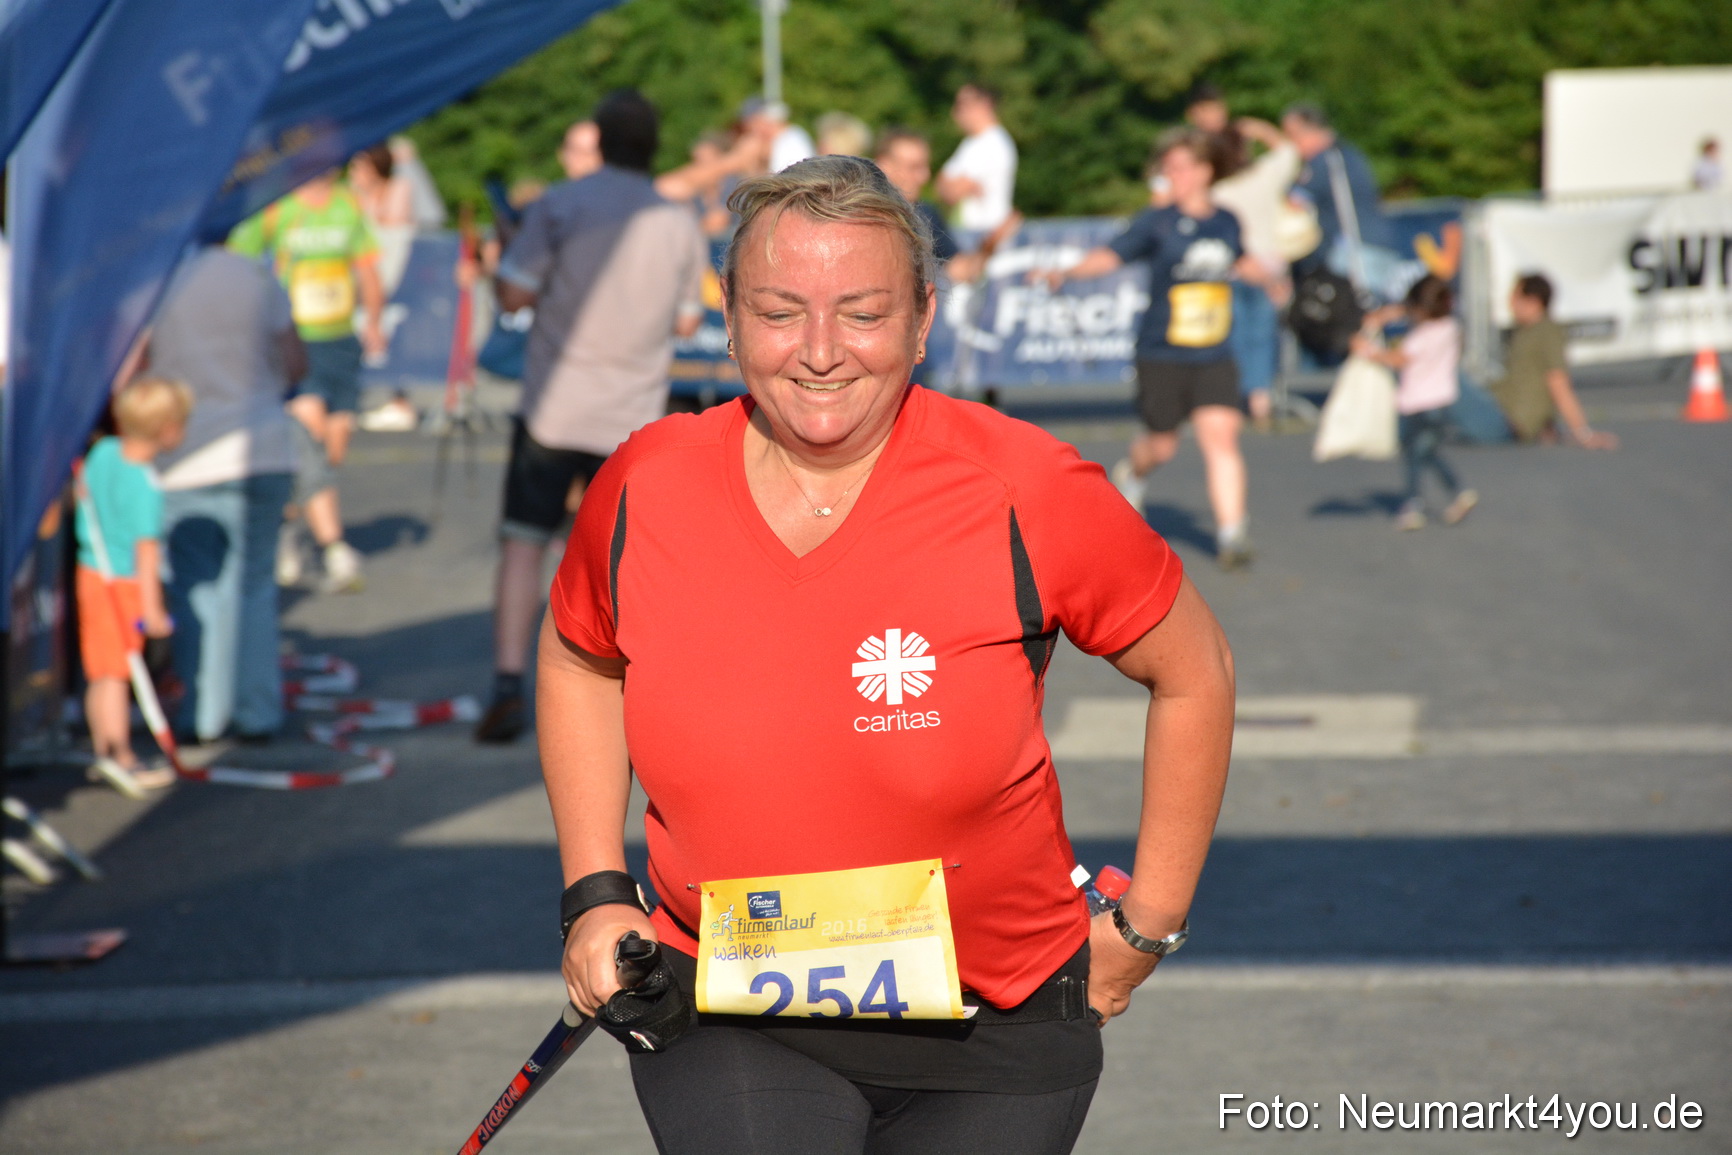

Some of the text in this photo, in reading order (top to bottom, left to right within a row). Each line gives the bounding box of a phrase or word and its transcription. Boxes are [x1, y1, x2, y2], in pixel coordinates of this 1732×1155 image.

[853, 709, 941, 732] caritas
[738, 912, 817, 933] firmenlauf
[821, 918, 867, 936] 2016
[714, 942, 777, 961] walken
[749, 959, 909, 1019] 254
[478, 1082, 522, 1141] NORDIC
